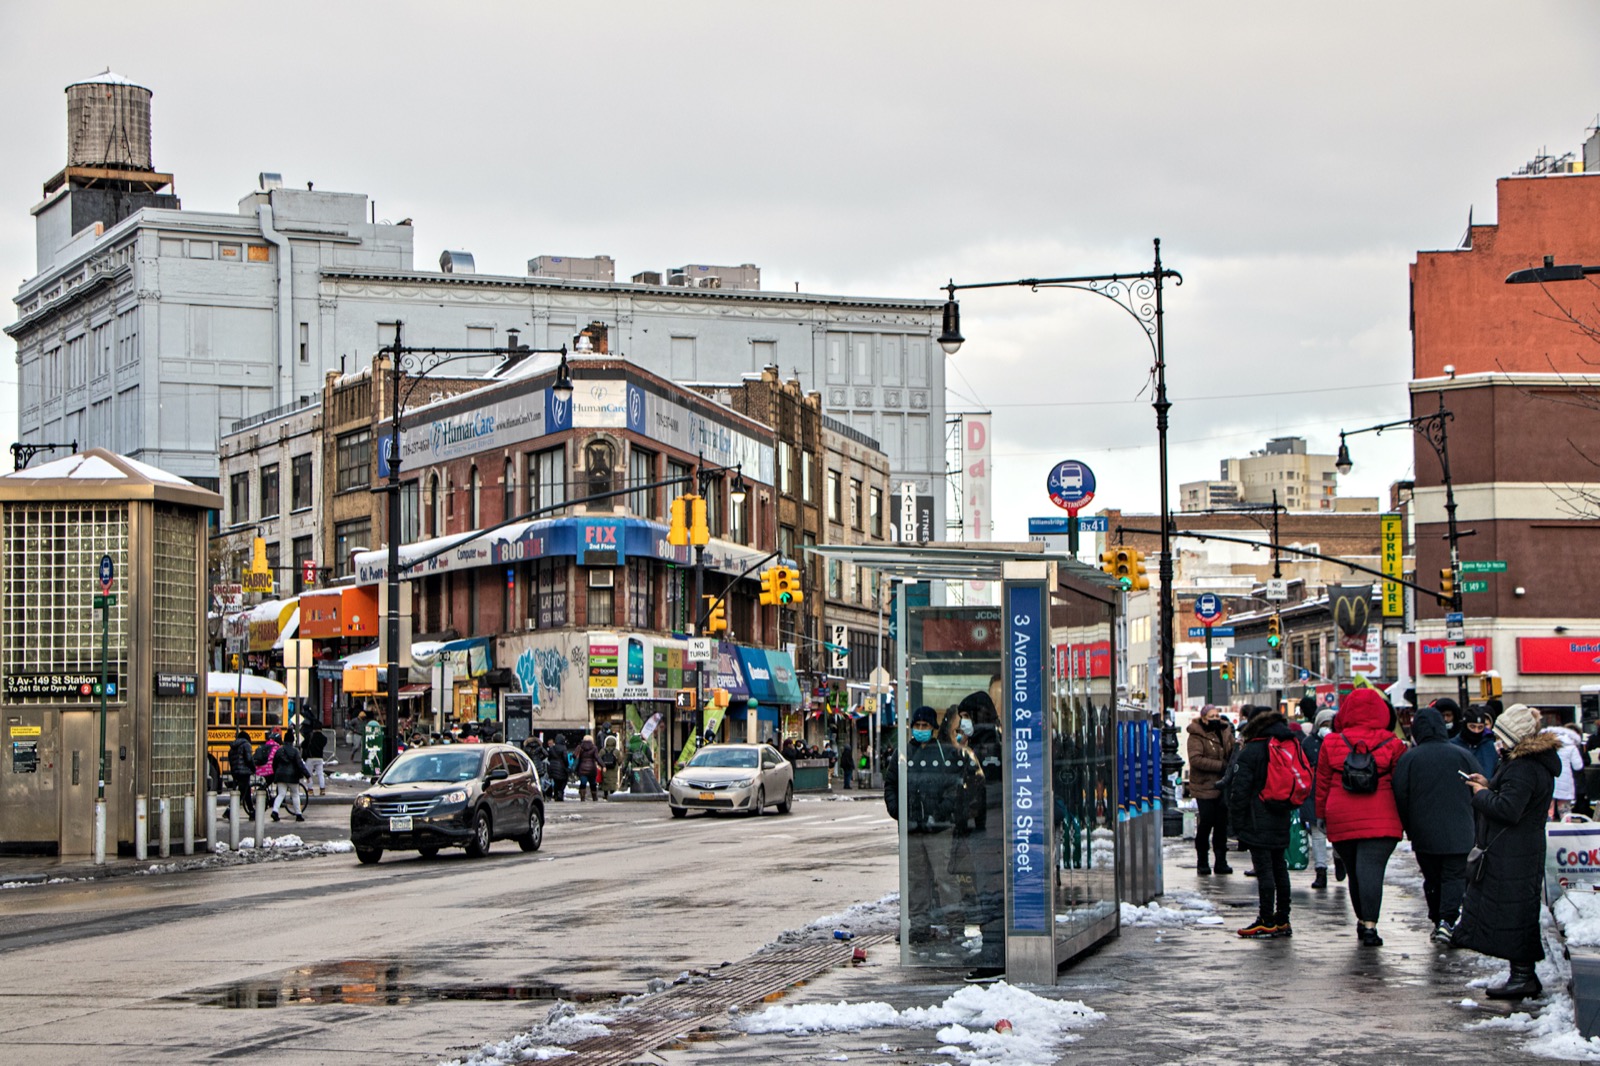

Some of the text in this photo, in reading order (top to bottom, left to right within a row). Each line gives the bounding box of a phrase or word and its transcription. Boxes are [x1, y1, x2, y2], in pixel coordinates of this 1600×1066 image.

[572, 403, 627, 412] HumanCare
[443, 412, 495, 446] HumanCare
[1053, 493, 1092, 508] NO STANDING
[904, 484, 914, 541] TATTOO
[1080, 520, 1105, 531] Bx41
[585, 526, 617, 543] FIX
[456, 547, 477, 562] Computer
[369, 565, 383, 580] Phone
[243, 573, 272, 588] FABRIC
[213, 584, 242, 595] INCOME
[1469, 582, 1480, 591] 149
[222, 595, 236, 604] TAX
[347, 623, 366, 631] NAILS
[1570, 643, 1591, 652] Bank
[1454, 651, 1466, 659] NO
[1271, 664, 1280, 672] NO
[1448, 662, 1474, 670] TURNS
[8, 675, 98, 685] 3 Av-149 St Station
[717, 675, 737, 688] EXPRESS
[50, 685, 67, 693] Dyre
[84, 685, 89, 693] 2
[1014, 614, 1034, 873] 3 Avenue & East 149 Street
[1556, 847, 1600, 867] COOK
